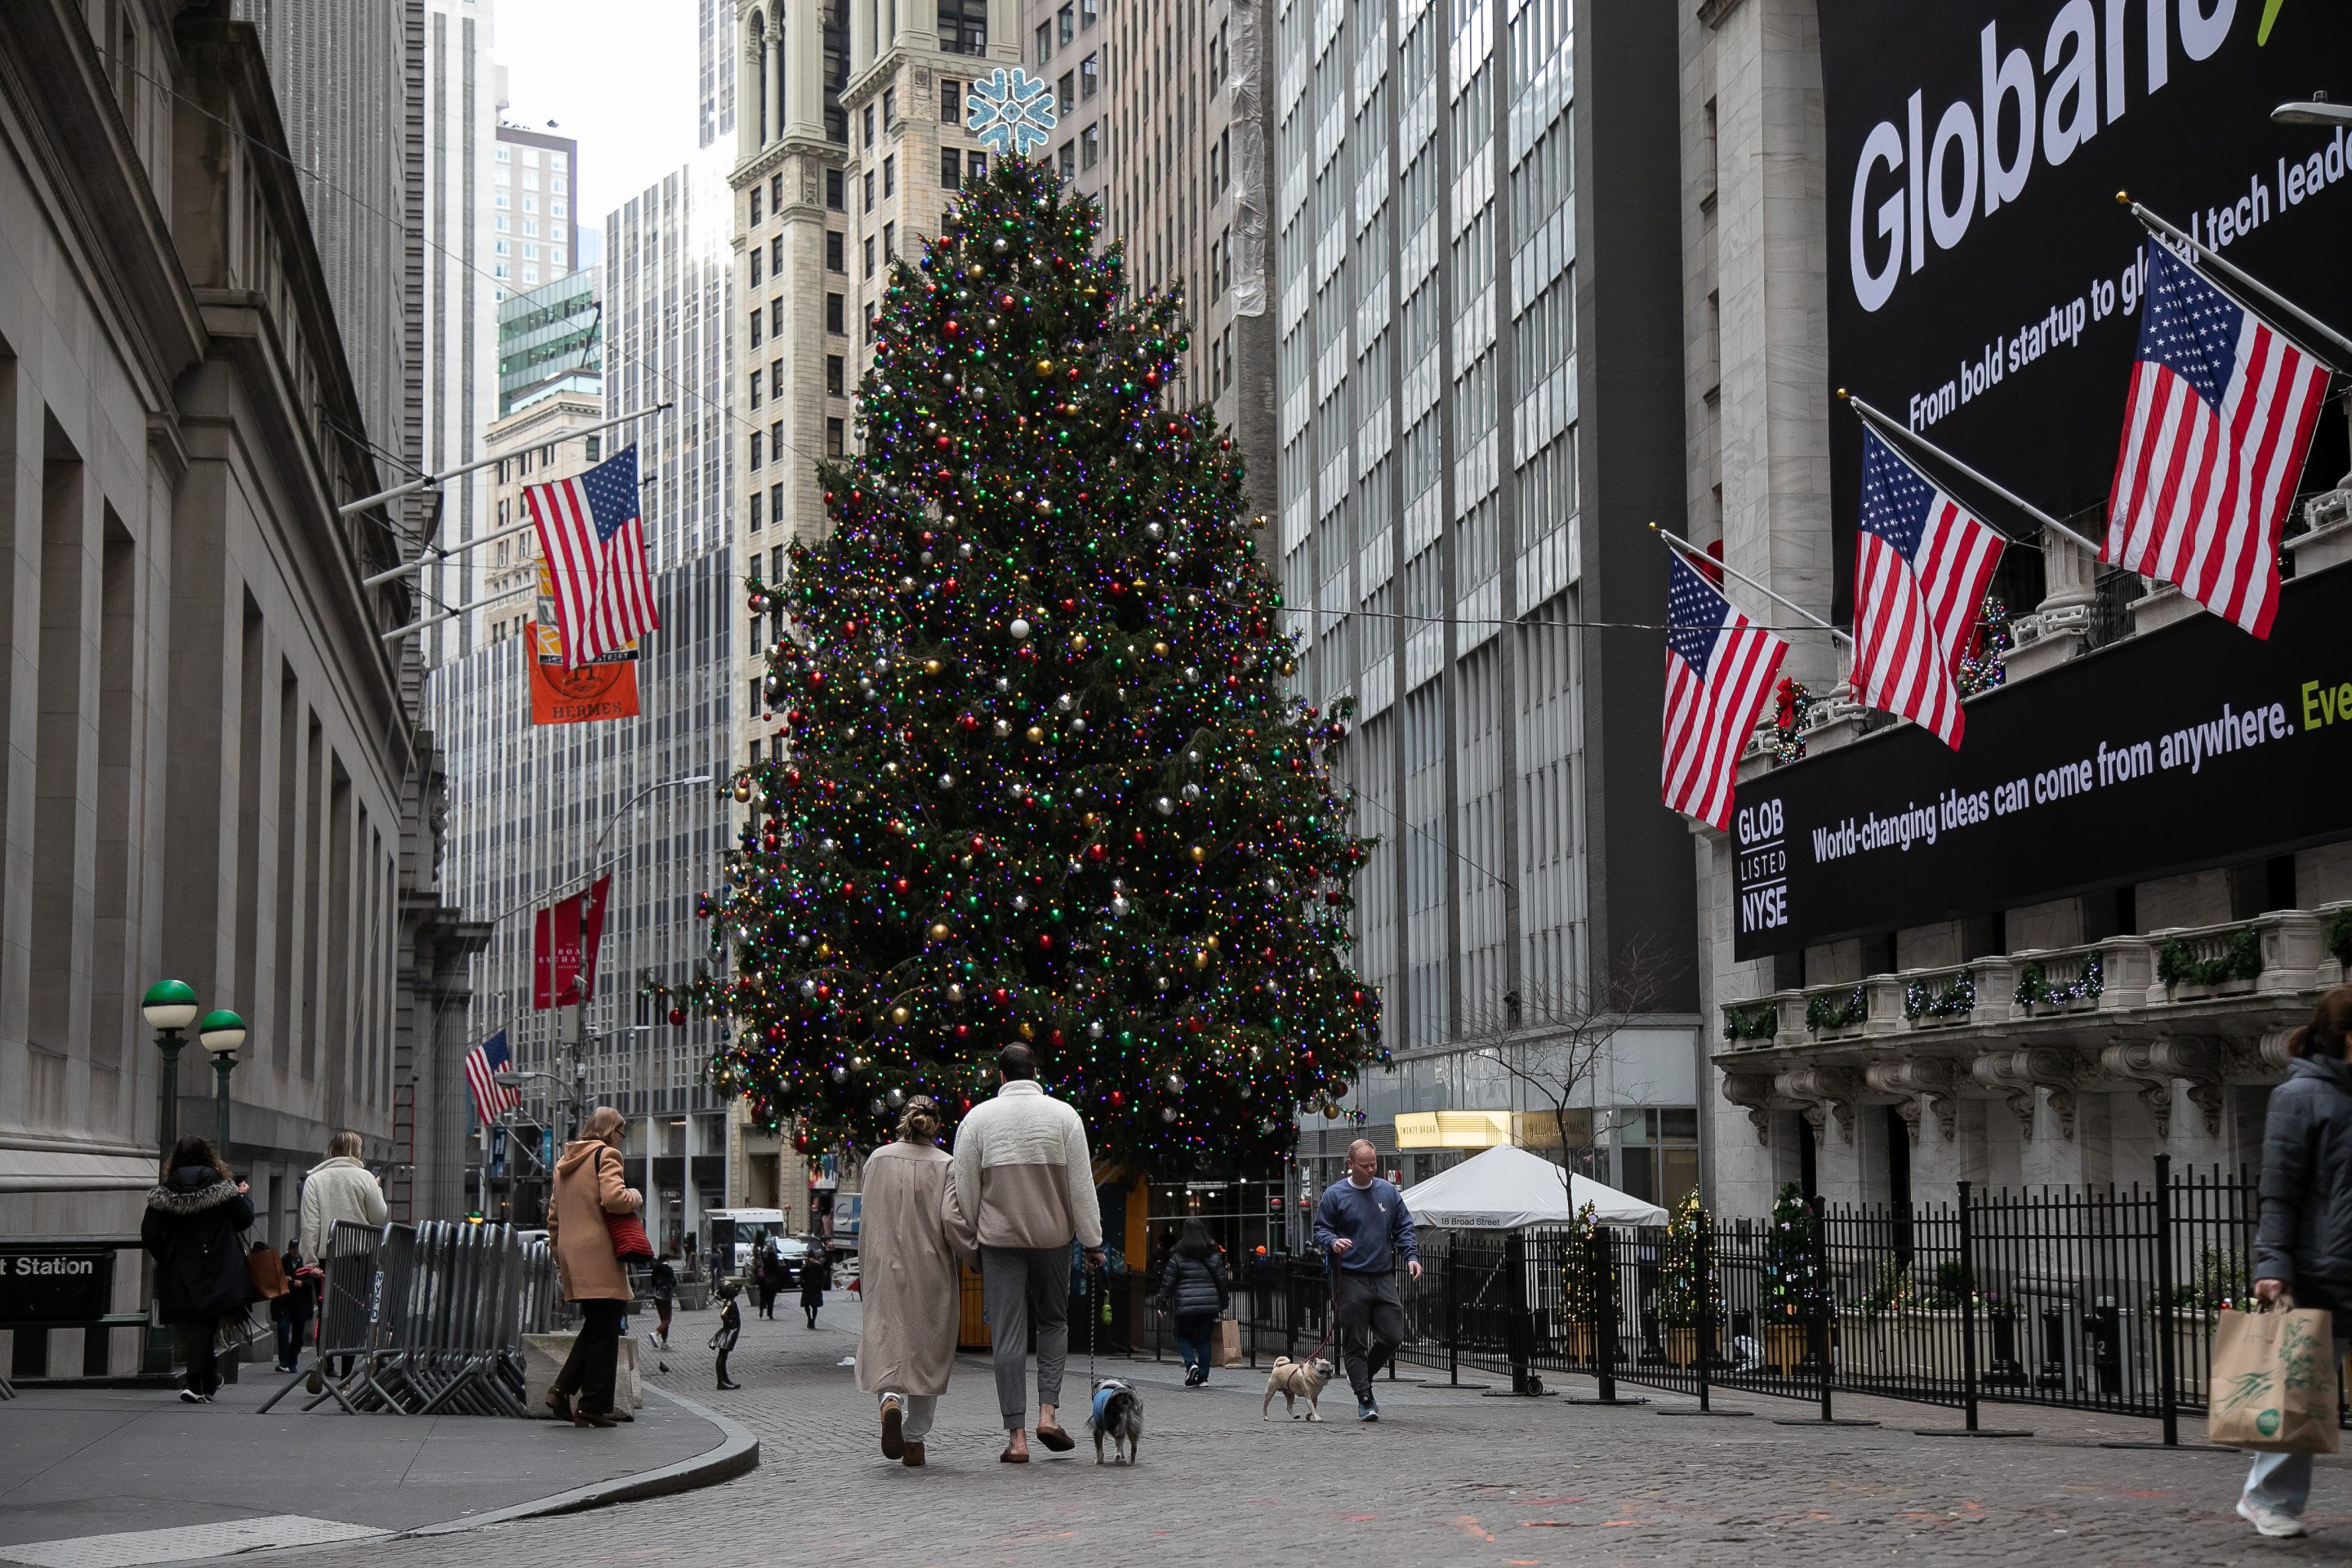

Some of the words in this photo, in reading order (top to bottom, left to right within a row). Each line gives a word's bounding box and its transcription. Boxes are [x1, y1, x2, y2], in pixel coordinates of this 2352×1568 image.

[1909, 381, 1956, 434] From
[1961, 336, 2003, 405] bold
[2008, 296, 2086, 373] startup
[2091, 279, 2115, 322] to
[2121, 212, 2199, 316] glal
[2207, 174, 2270, 254] tech
[1812, 801, 1937, 863] World-changing
[1940, 787, 1989, 831] ideas
[1993, 778, 2029, 816] can
[2034, 760, 2093, 804] come
[2096, 742, 2154, 787] from
[2159, 702, 2295, 774] anywhere.
[1738, 798, 1785, 845] GLOB
[1740, 849, 1786, 881] LISTED
[1742, 884, 1788, 933] NYSE
[1451, 1218, 1475, 1226] Broad
[1477, 1218, 1500, 1226] Street
[16, 1257, 93, 1276] Station
[372, 1272, 383, 1320] NYPD
